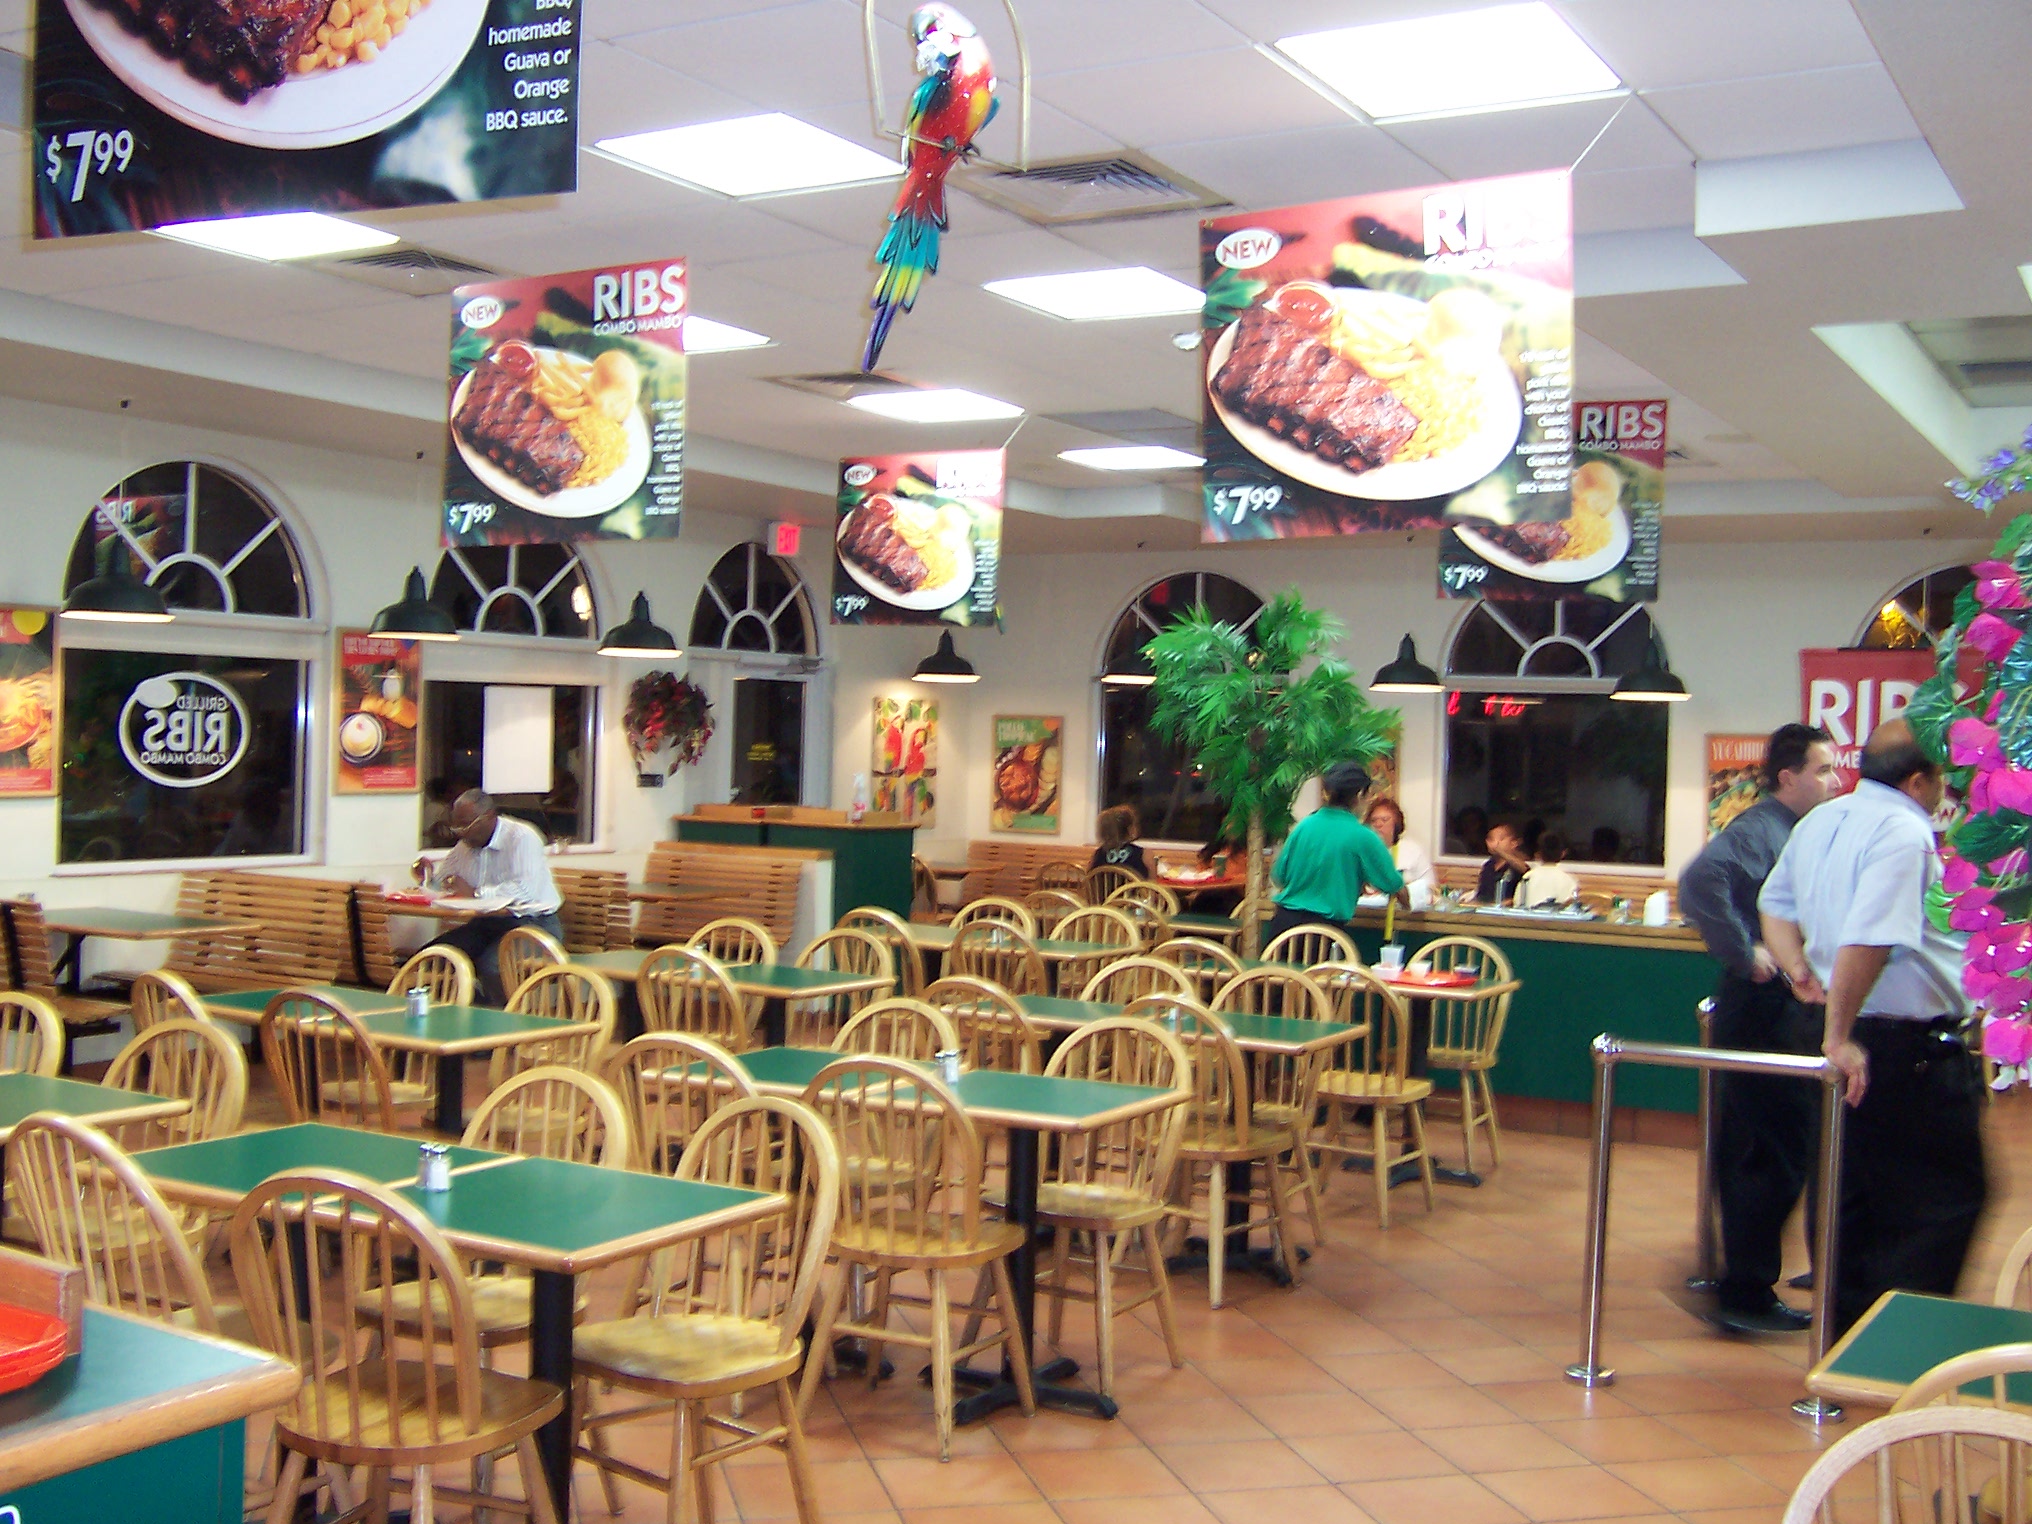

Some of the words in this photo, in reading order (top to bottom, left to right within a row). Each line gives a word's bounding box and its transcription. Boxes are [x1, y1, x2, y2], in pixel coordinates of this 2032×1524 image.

[487, 16, 573, 46] homemade
[503, 50, 551, 72] Guava
[553, 48, 572, 66] or
[513, 78, 571, 100] Orange
[485, 109, 519, 132] BBQ
[520, 107, 569, 128] sauce.
[1221, 236, 1273, 263] NEW
[593, 265, 685, 322] RIBS
[464, 303, 499, 323] NEW
[593, 319, 636, 336] COMBO
[1579, 403, 1665, 440] RIBS
